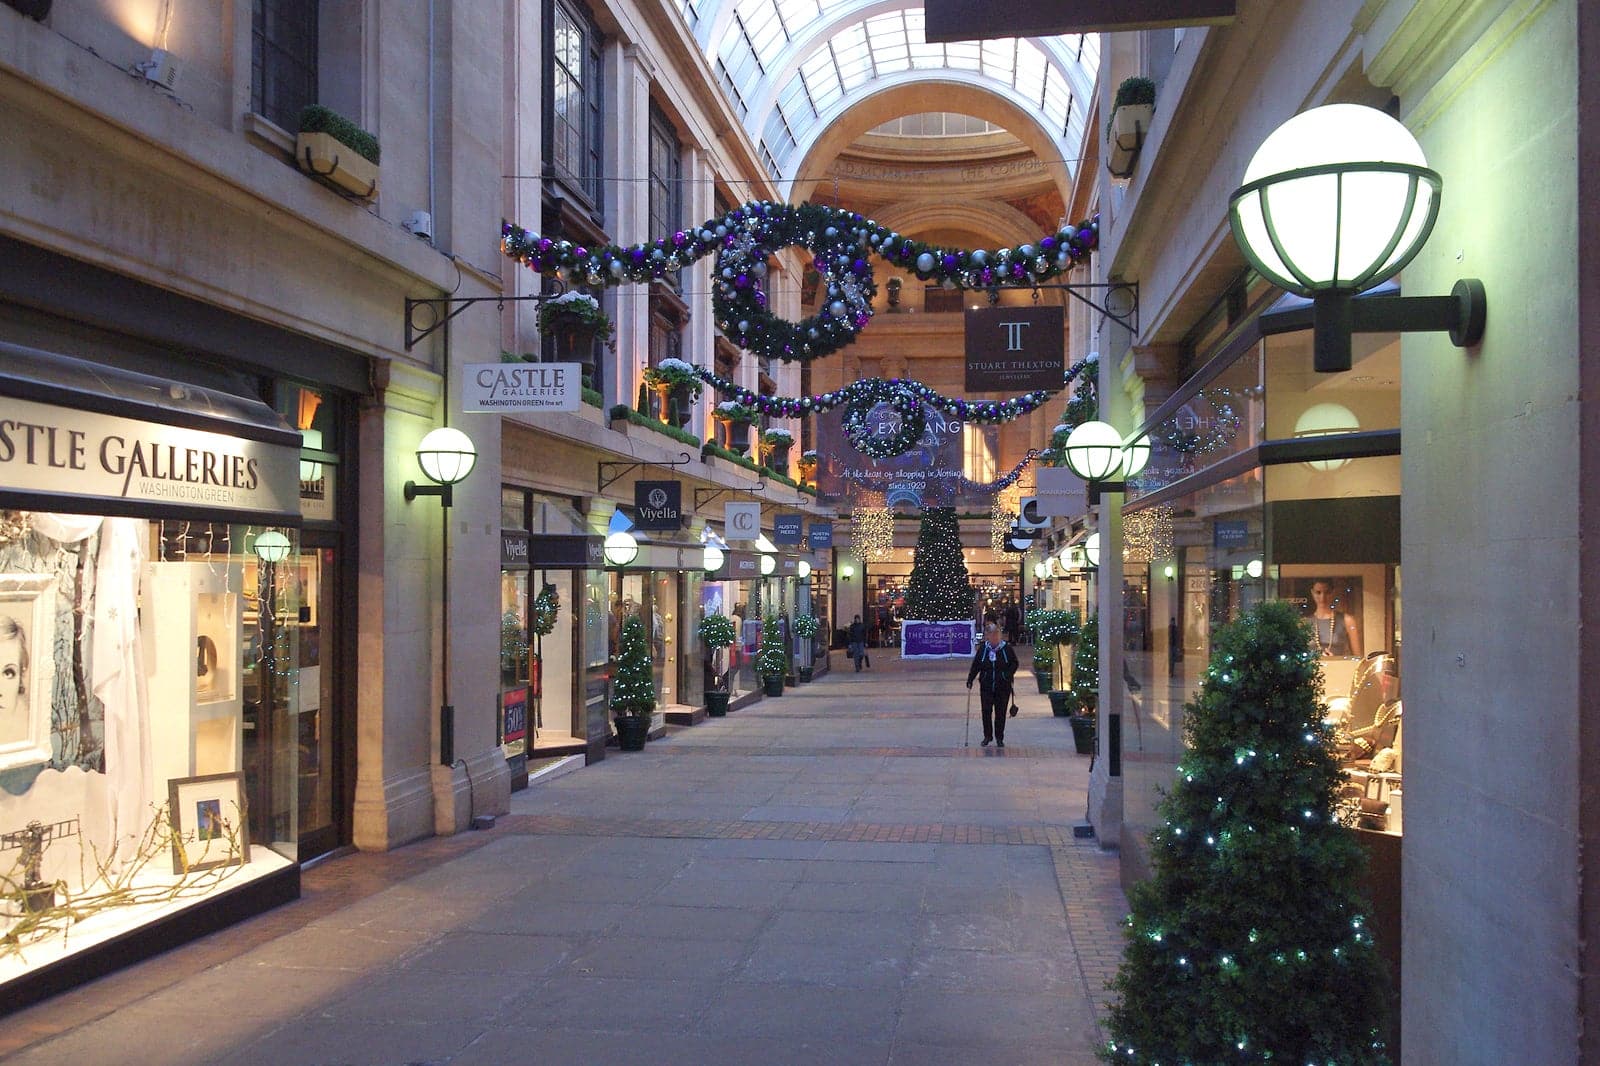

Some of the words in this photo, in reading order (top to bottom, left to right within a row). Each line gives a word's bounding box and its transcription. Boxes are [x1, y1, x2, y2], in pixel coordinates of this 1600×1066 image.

[968, 361, 1007, 370] STUART
[476, 368, 565, 398] CASTLE
[502, 388, 565, 396] GALLERIES
[99, 435, 259, 497] GALLERIES
[908, 481, 927, 491] 1929
[639, 506, 677, 522] Viyella
[505, 538, 526, 560] Viyella
